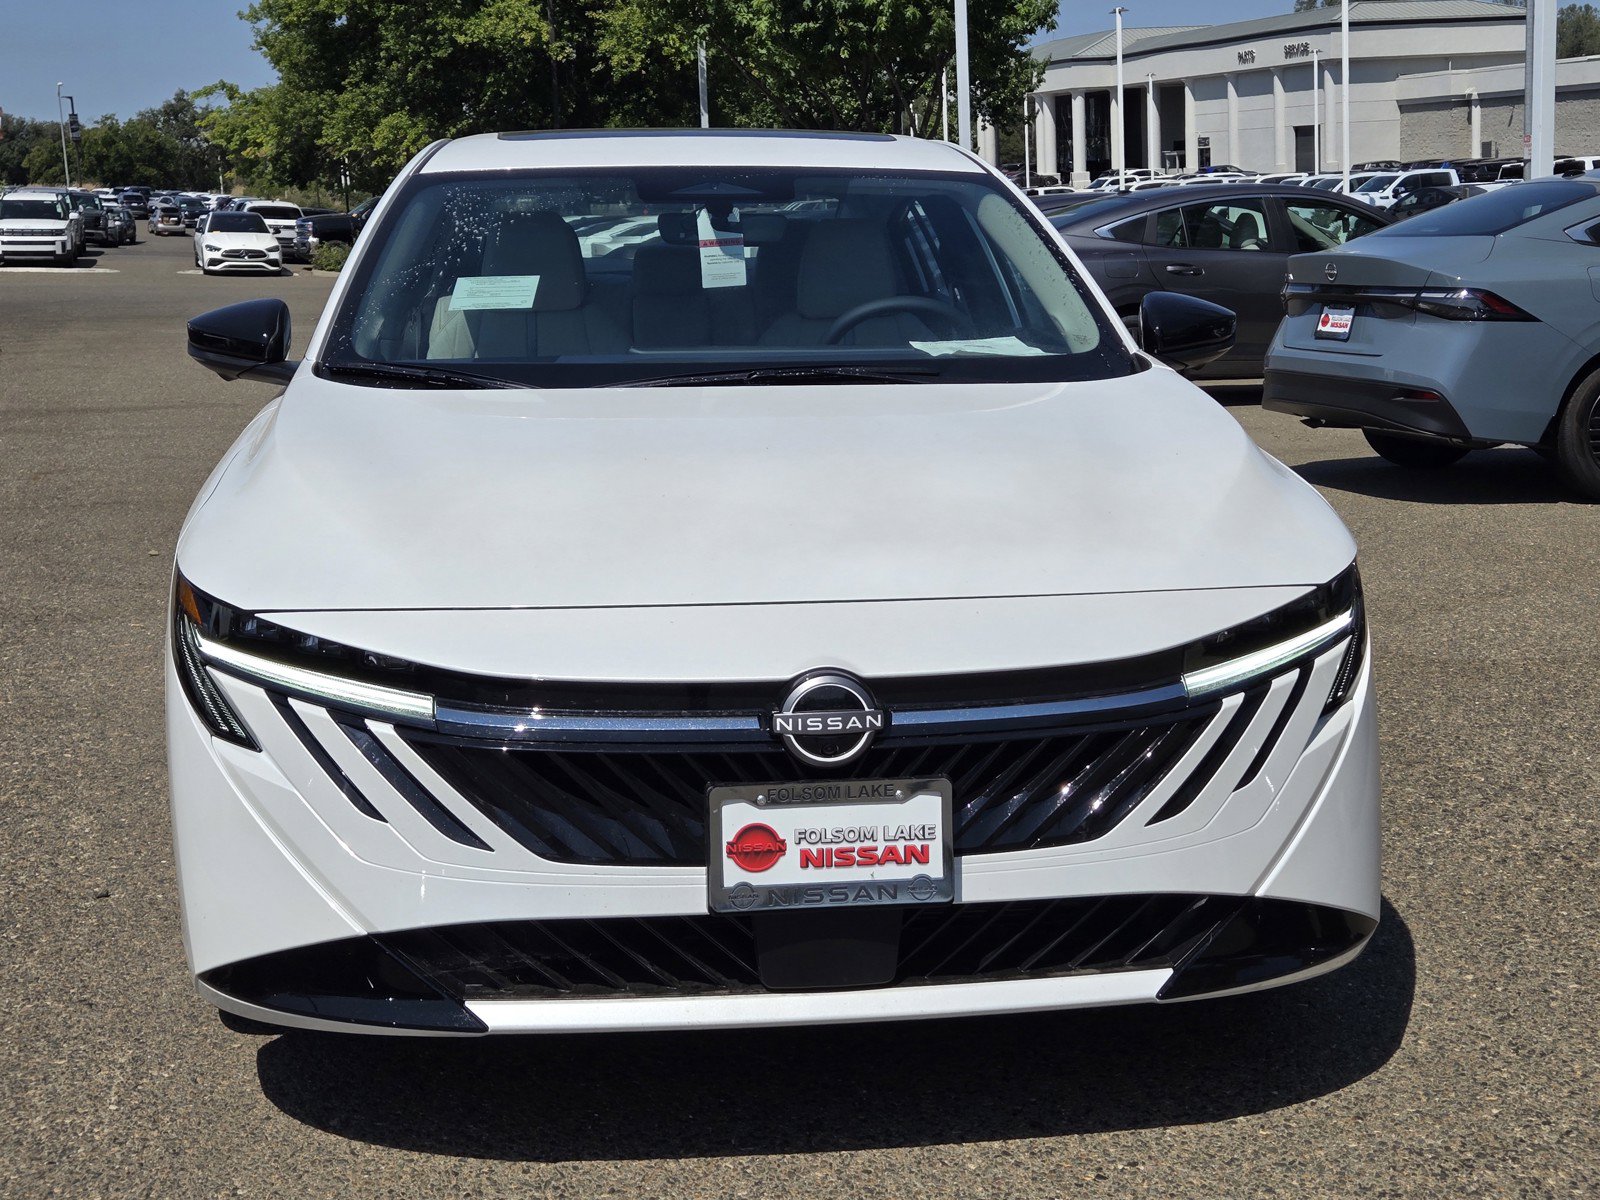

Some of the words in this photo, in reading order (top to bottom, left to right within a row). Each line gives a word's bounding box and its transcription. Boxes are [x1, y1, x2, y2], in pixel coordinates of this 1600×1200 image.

[1237, 50, 1256, 62] PARTS
[1284, 42, 1310, 55] SERVICE
[776, 714, 882, 731] NISSAN
[766, 785, 841, 803] FOLSOM
[846, 784, 896, 799] LAKE
[794, 825, 878, 845] FOLSOM
[883, 823, 937, 842] LAKE
[726, 842, 787, 854] NISSAN
[799, 844, 930, 868] NISSAN
[768, 885, 900, 907] NISSAN
